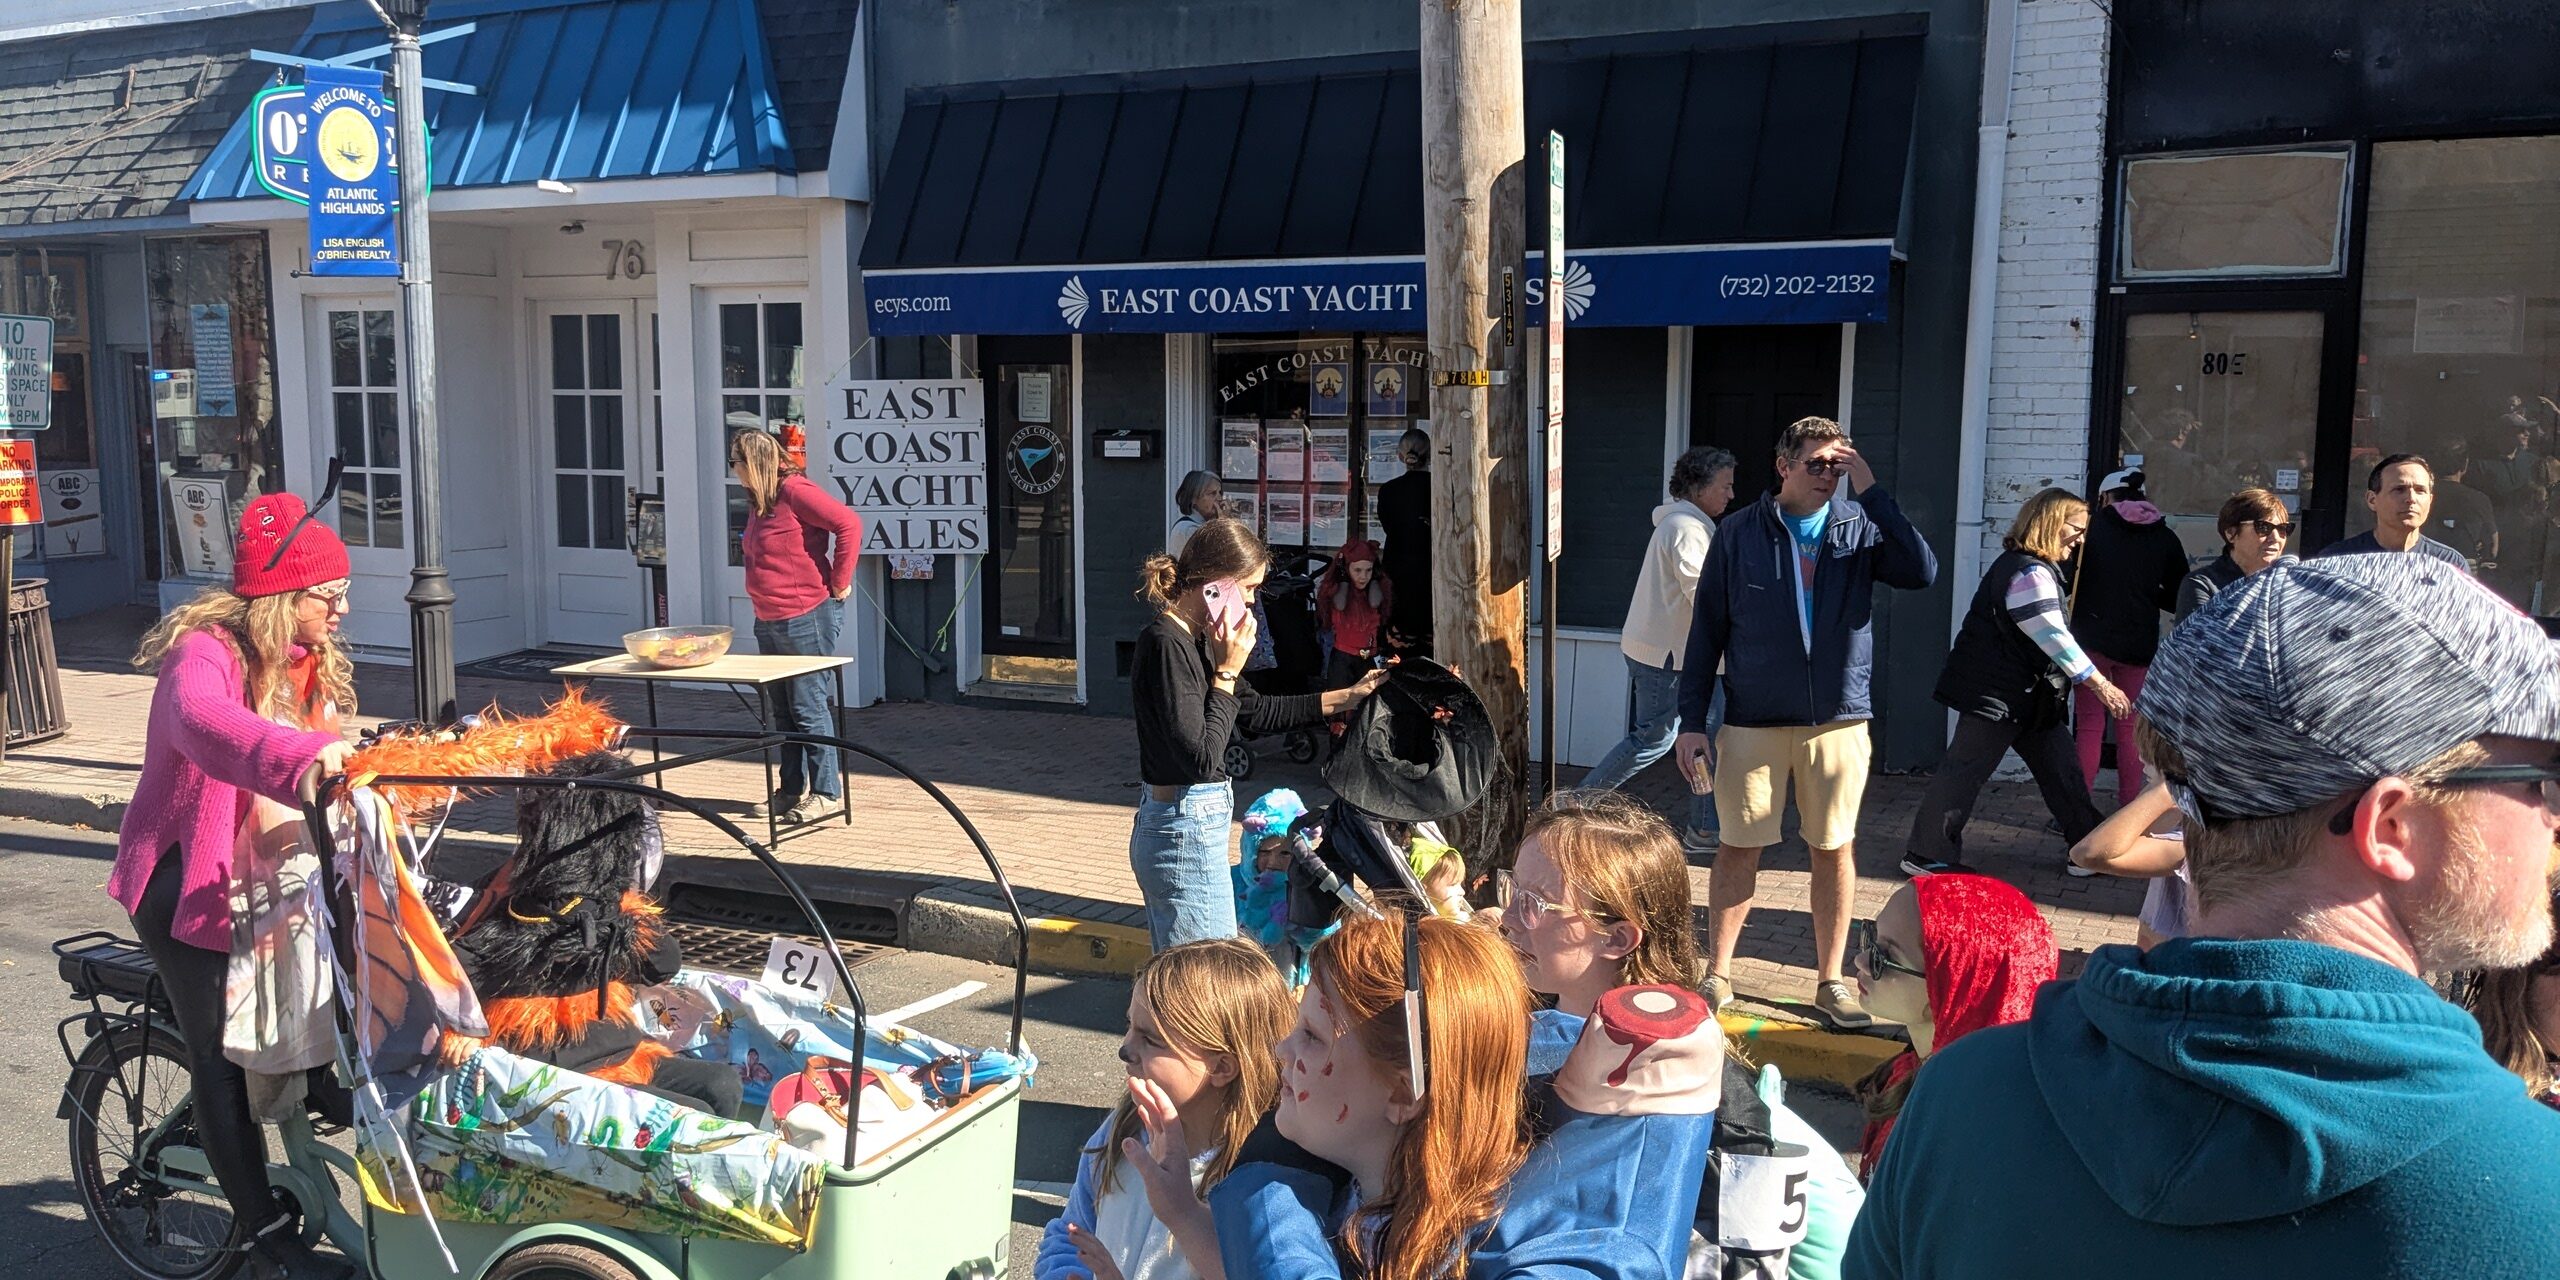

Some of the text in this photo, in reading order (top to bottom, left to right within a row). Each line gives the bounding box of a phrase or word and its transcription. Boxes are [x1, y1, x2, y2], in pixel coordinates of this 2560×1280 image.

[310, 87, 382, 118] WELCOME TO
[326, 187, 379, 201] ATLANTIC
[319, 202, 386, 215] HIGHLANDS
[323, 238, 385, 248] LISA ENGLISH
[317, 250, 391, 260] O'BRIEN REALTY
[602, 239, 645, 280] 76
[1720, 273, 1875, 298] (732) 202-2132
[874, 295, 952, 318] ecys.com
[1100, 283, 1419, 314] EAST COAST YACHT
[1504, 274, 1513, 346] 53142
[4, 321, 24, 345] 10
[1, 346, 37, 361] INUTE
[2, 362, 39, 377] RKING
[1218, 343, 1425, 403] EAST COAST YACH
[11, 378, 46, 393] SPACE
[842, 386, 967, 420] EAST
[0, 409, 40, 423] M-8PM
[833, 430, 980, 464] COAST
[1012, 427, 1060, 446] EAST COAST
[2, 446, 16, 457] NO
[0, 476, 34, 486] MPORARY
[58, 477, 81, 490] ABC
[1010, 467, 1061, 492] YACHT SALES
[0, 488, 31, 498] POLICE
[187, 489, 205, 504] ABC
[832, 474, 983, 507] YACHT
[1, 500, 31, 509] ORDER
[861, 518, 980, 550] ALES
[782, 949, 819, 992] 73
[1778, 1169, 1809, 1234] 5
